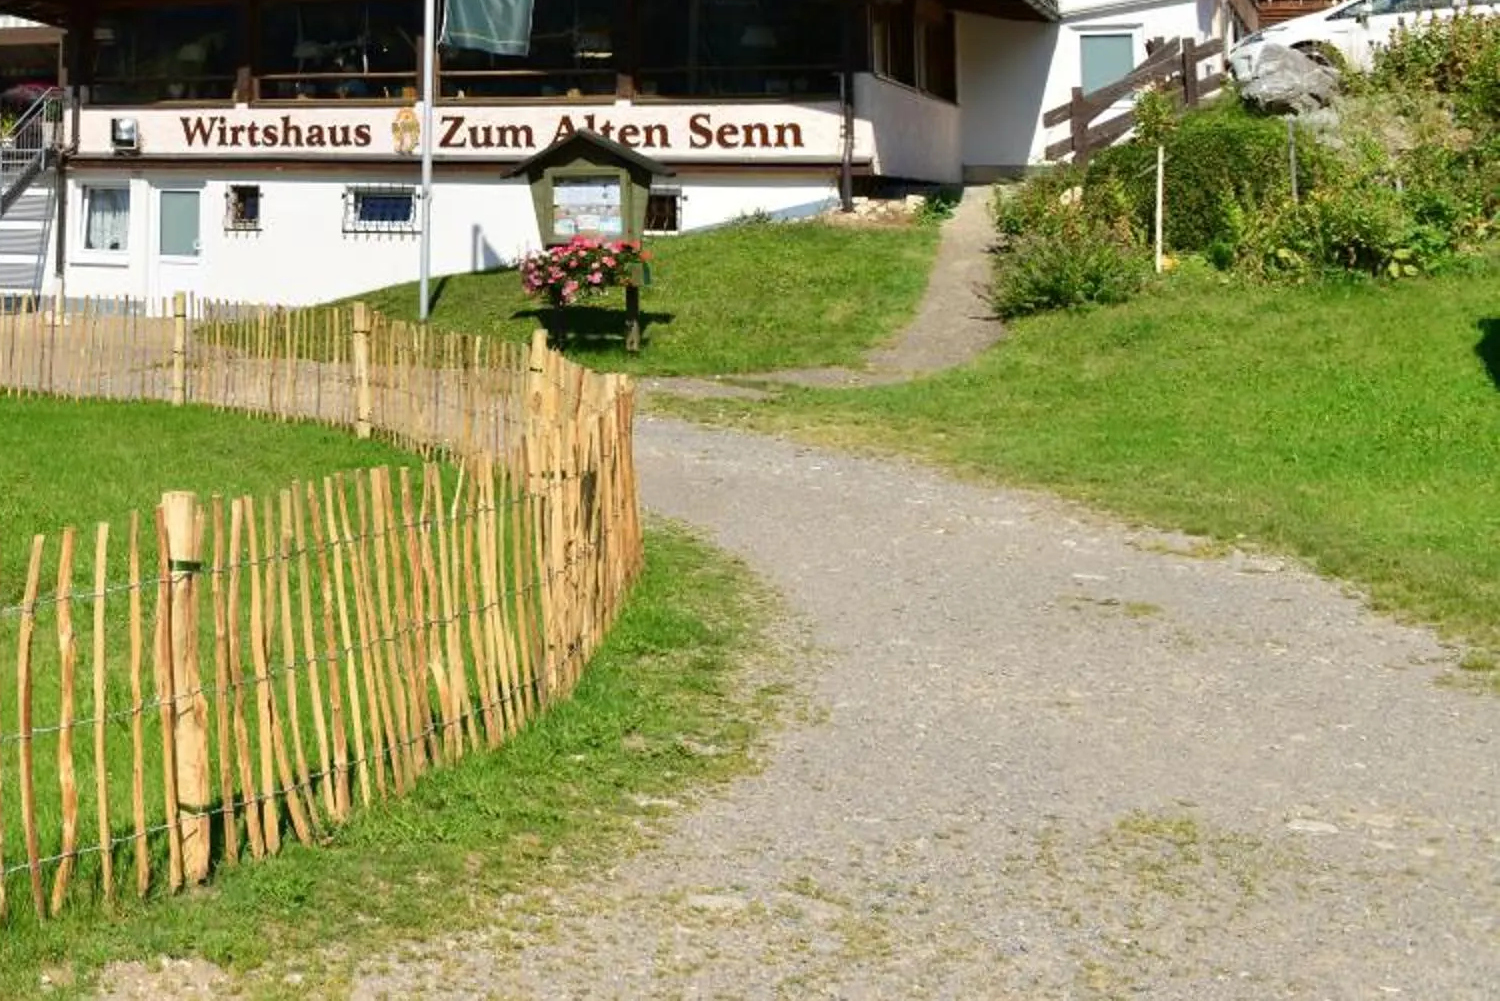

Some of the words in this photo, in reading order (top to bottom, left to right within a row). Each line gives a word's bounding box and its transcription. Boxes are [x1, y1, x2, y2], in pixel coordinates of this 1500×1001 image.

[180, 115, 372, 147] Wirtshaus
[439, 115, 535, 148] Zum
[552, 113, 671, 148] Alten
[689, 113, 805, 149] Senn
